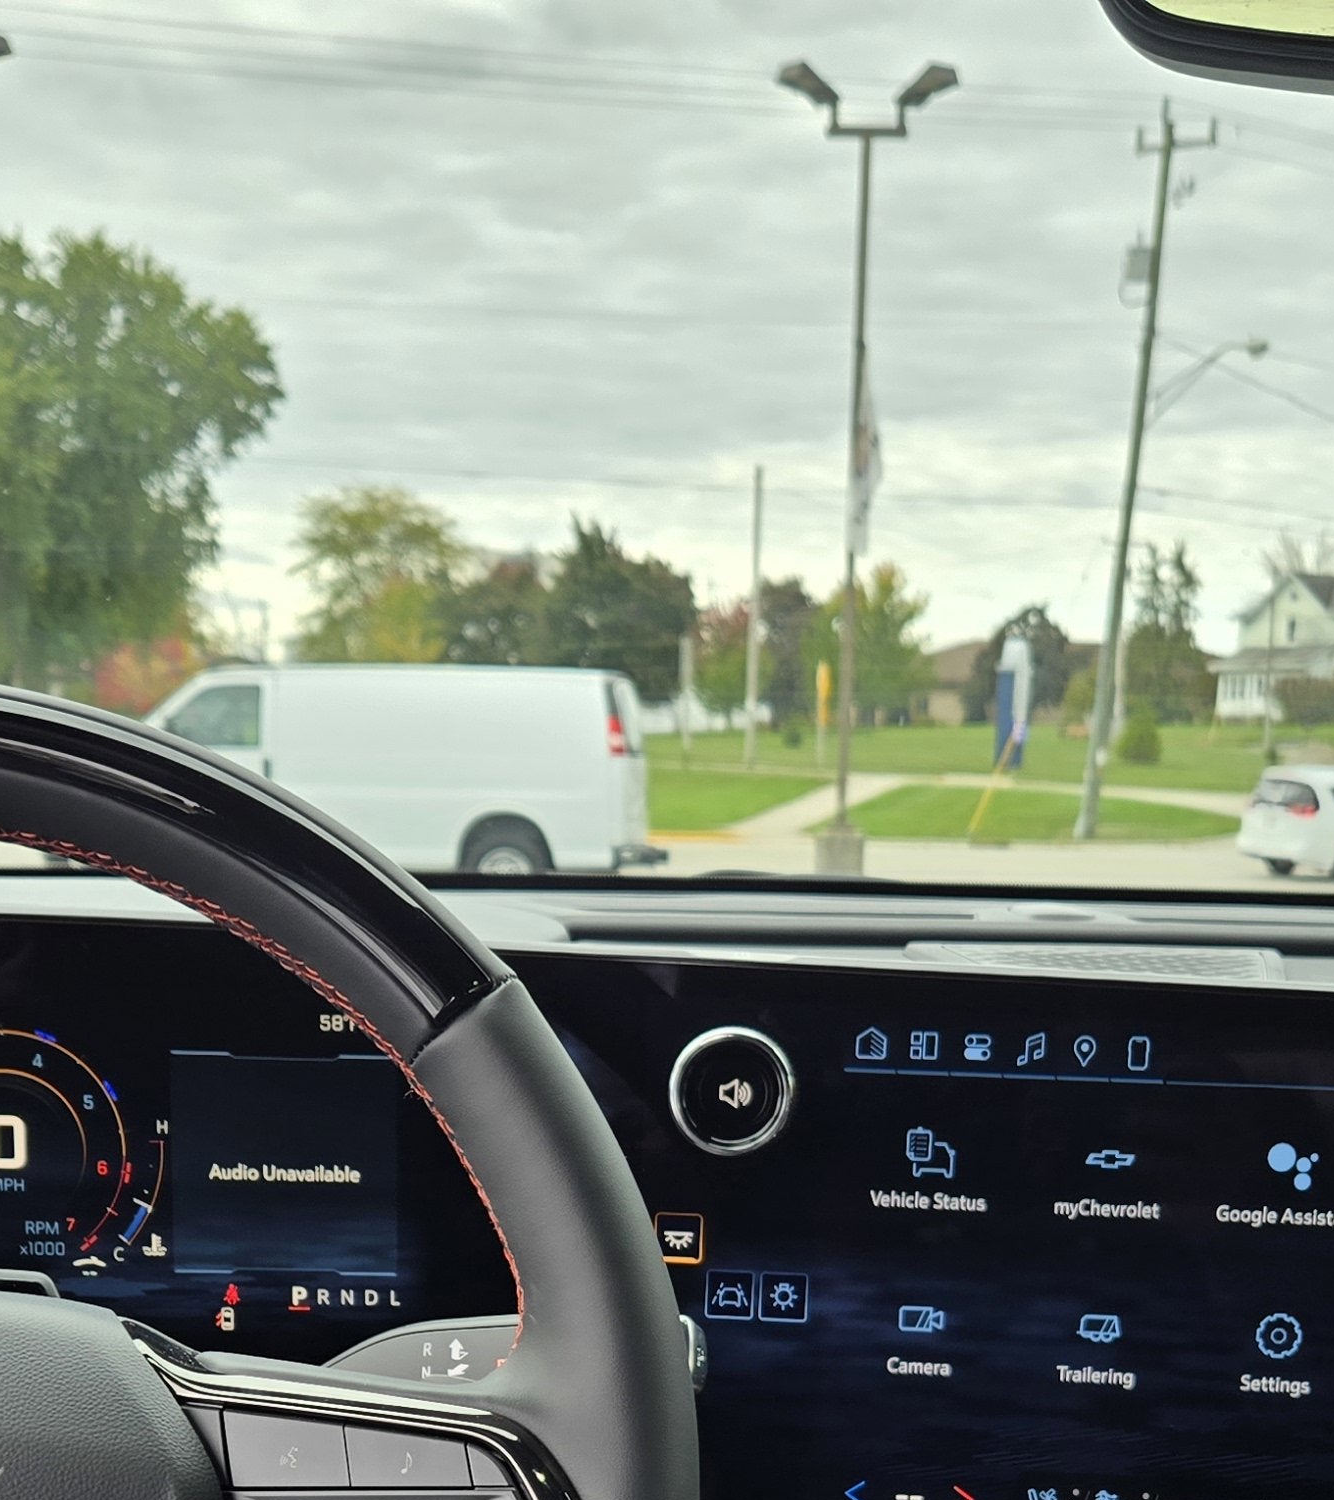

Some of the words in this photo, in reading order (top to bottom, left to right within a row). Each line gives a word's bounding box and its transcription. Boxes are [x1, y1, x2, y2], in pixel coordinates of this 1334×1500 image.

[31, 1053, 44, 1068] 4
[82, 1094, 95, 1110] 5
[156, 1119, 169, 1135] H
[97, 1160, 109, 1176] 6
[208, 1162, 258, 1181] Audio
[259, 1163, 362, 1184] Unavailable
[869, 1189, 931, 1210] Vehicle
[932, 1191, 988, 1212] Status
[1053, 1198, 1161, 1220] myChevrolet
[1215, 1204, 1279, 1228] Google
[24, 1220, 60, 1235] RPM
[66, 1217, 76, 1232] 7
[19, 1240, 66, 1257] x1000
[113, 1247, 125, 1262] C
[292, 1286, 307, 1304] P
[317, 1288, 331, 1306] R
[340, 1288, 355, 1306] N
[364, 1289, 379, 1306] D
[389, 1289, 401, 1307] L
[422, 1342, 432, 1357] R
[421, 1366, 431, 1379] N
[886, 1356, 953, 1377] Camera
[1055, 1364, 1136, 1390] Trailering
[1239, 1373, 1311, 1399] Settings
